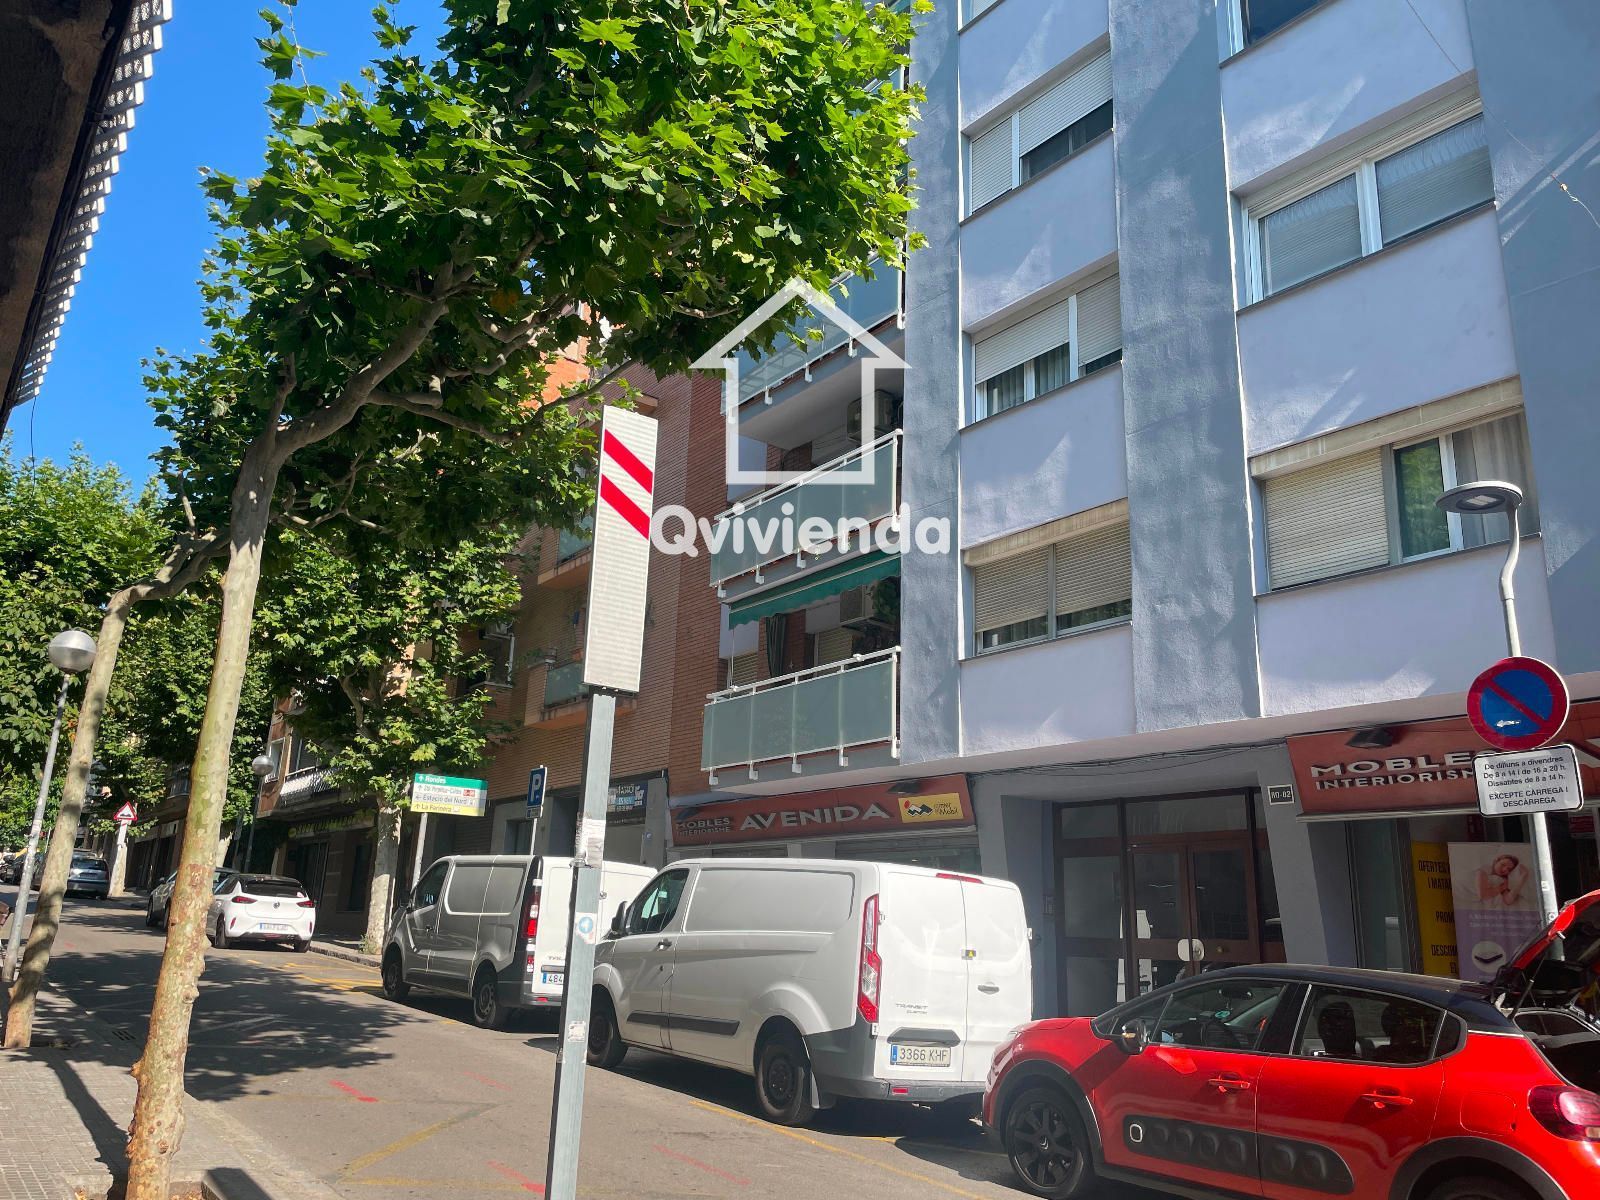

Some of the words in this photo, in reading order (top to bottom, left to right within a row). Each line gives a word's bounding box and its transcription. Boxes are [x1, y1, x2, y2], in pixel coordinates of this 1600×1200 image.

[1311, 751, 1476, 777] MOBLE
[1528, 756, 1563, 765] divendres
[531, 773, 541, 802] P
[1316, 769, 1473, 790] INTERIORISM
[1489, 790, 1523, 800] EXCEPTE
[740, 803, 890, 831] AVENIDA
[548, 974, 563, 983] 484
[899, 1048, 926, 1061] 3366
[928, 1049, 948, 1062] KHF
